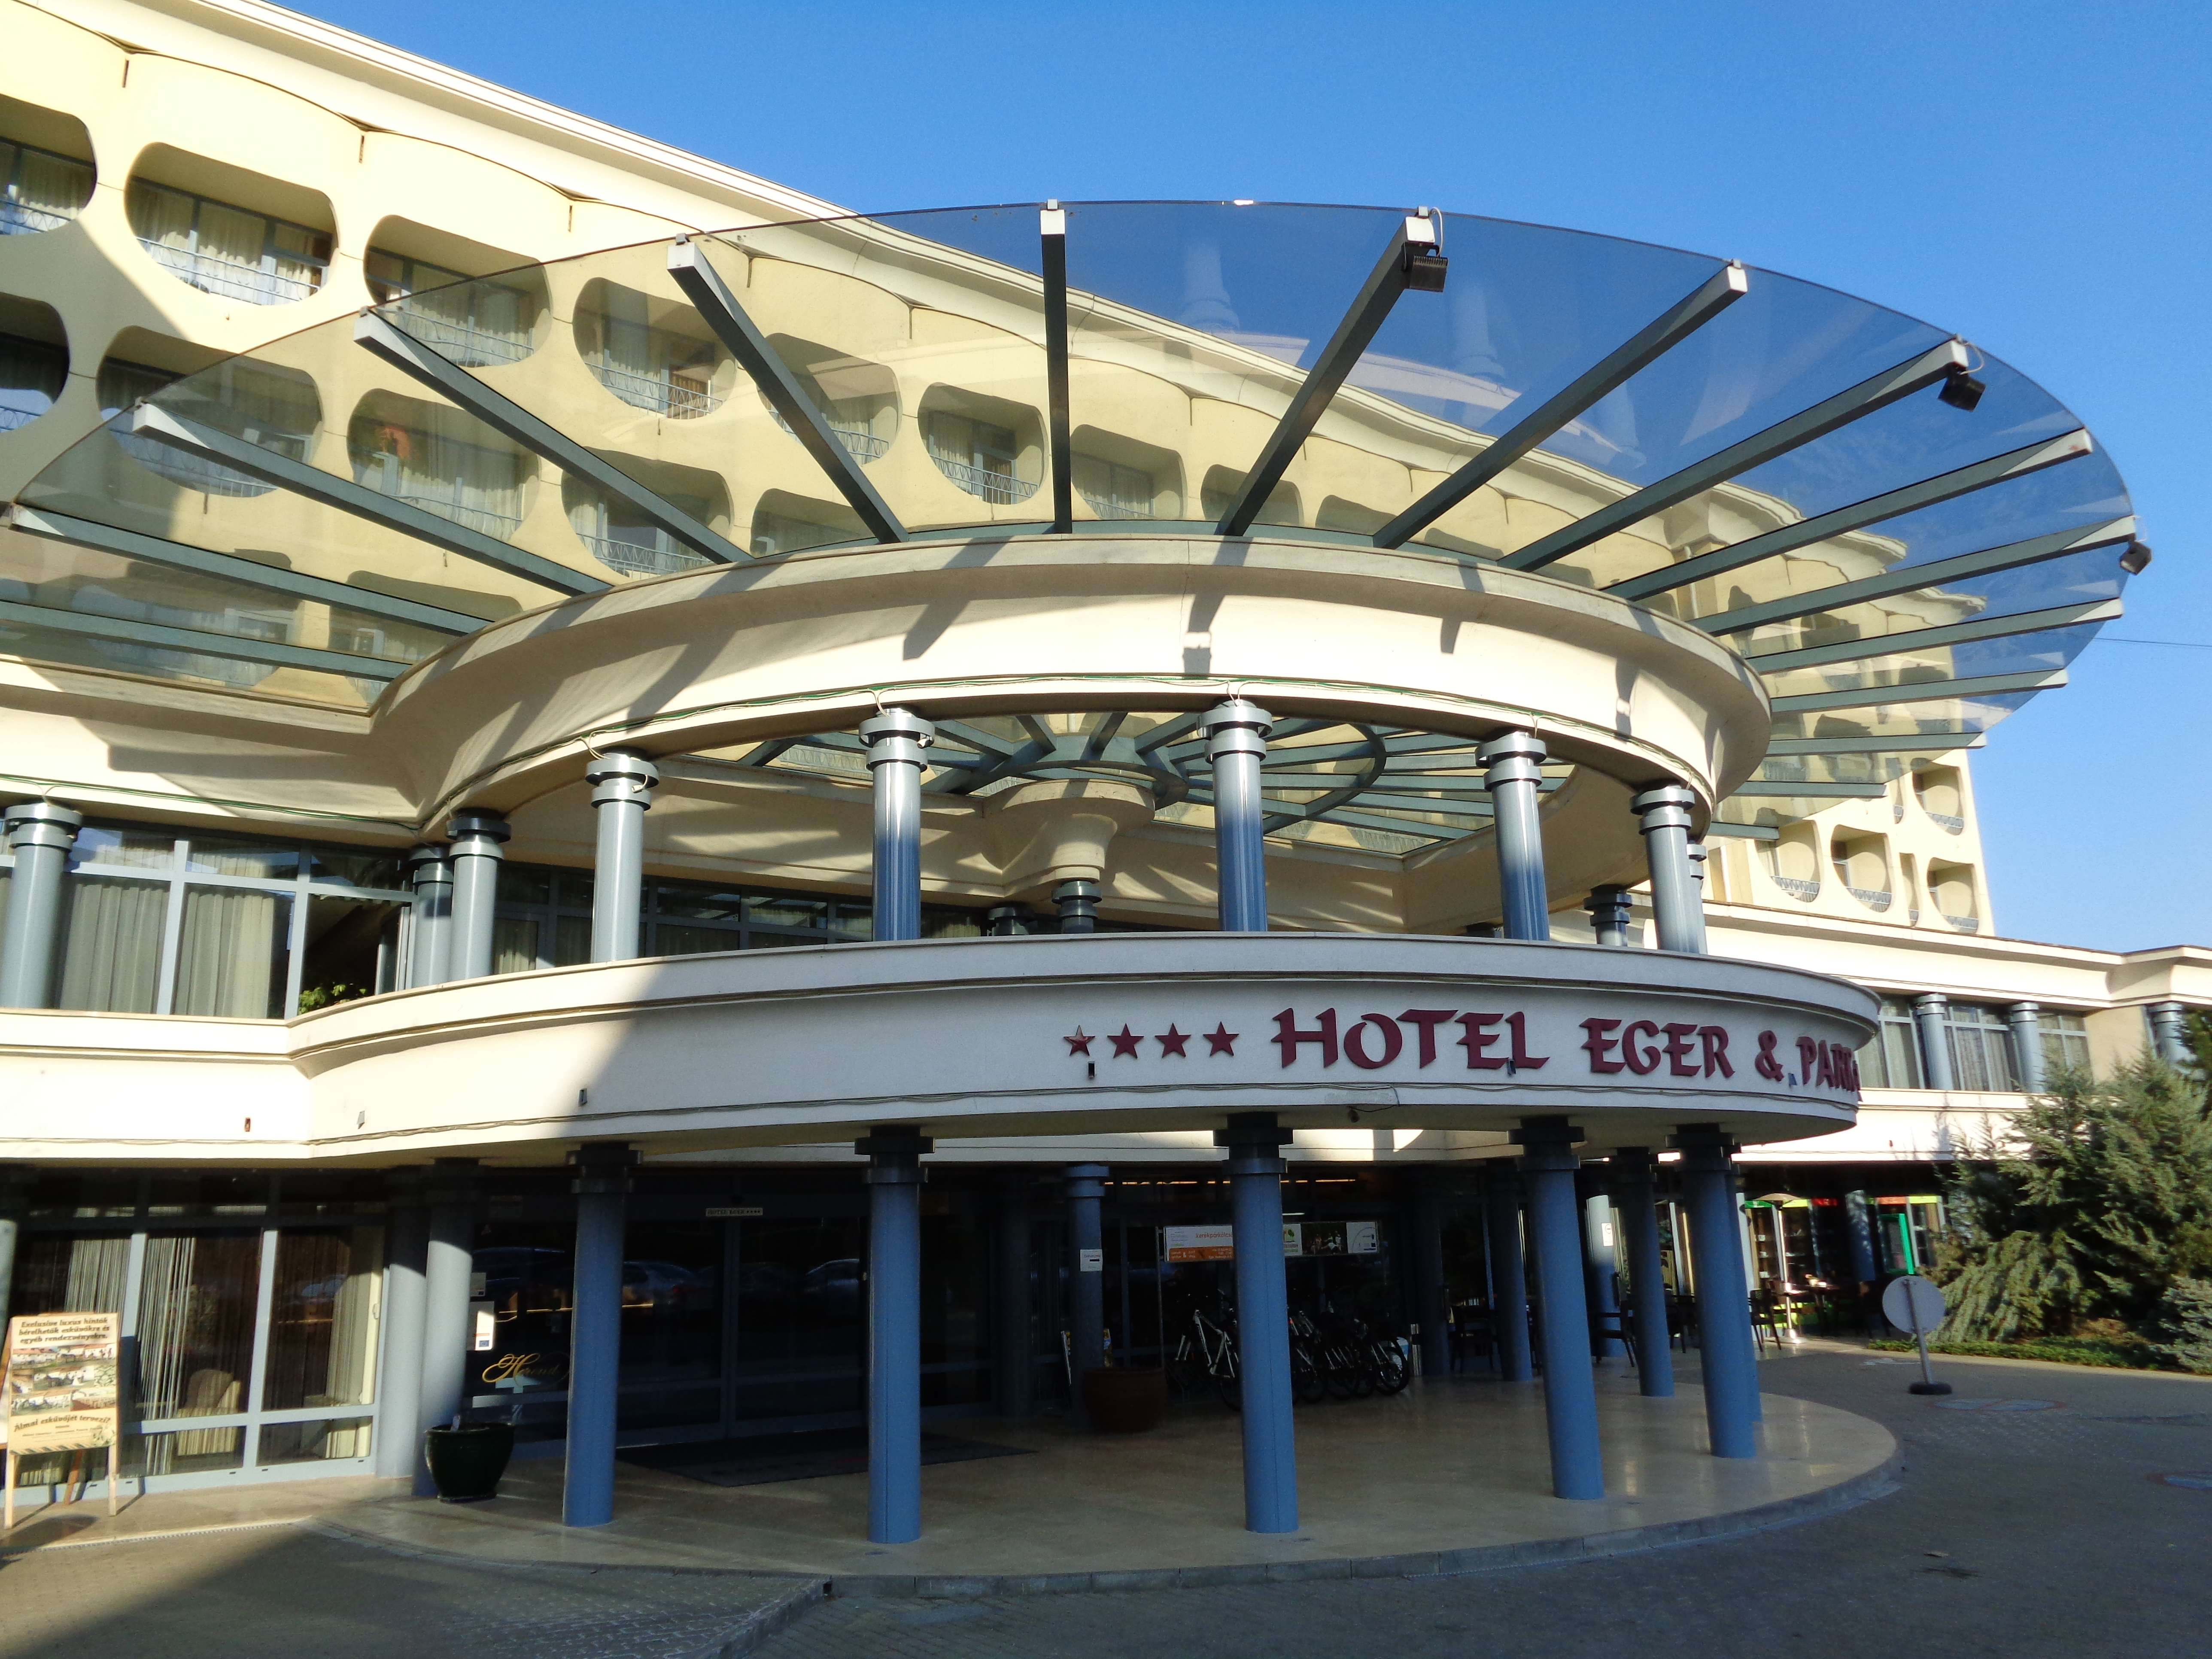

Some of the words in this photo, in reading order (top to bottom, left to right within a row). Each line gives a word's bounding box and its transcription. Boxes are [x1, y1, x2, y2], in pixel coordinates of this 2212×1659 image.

[1271, 1008, 1550, 1070] HOTEL
[1580, 1017, 1735, 1078] EGER
[1756, 1030, 1784, 1082] &
